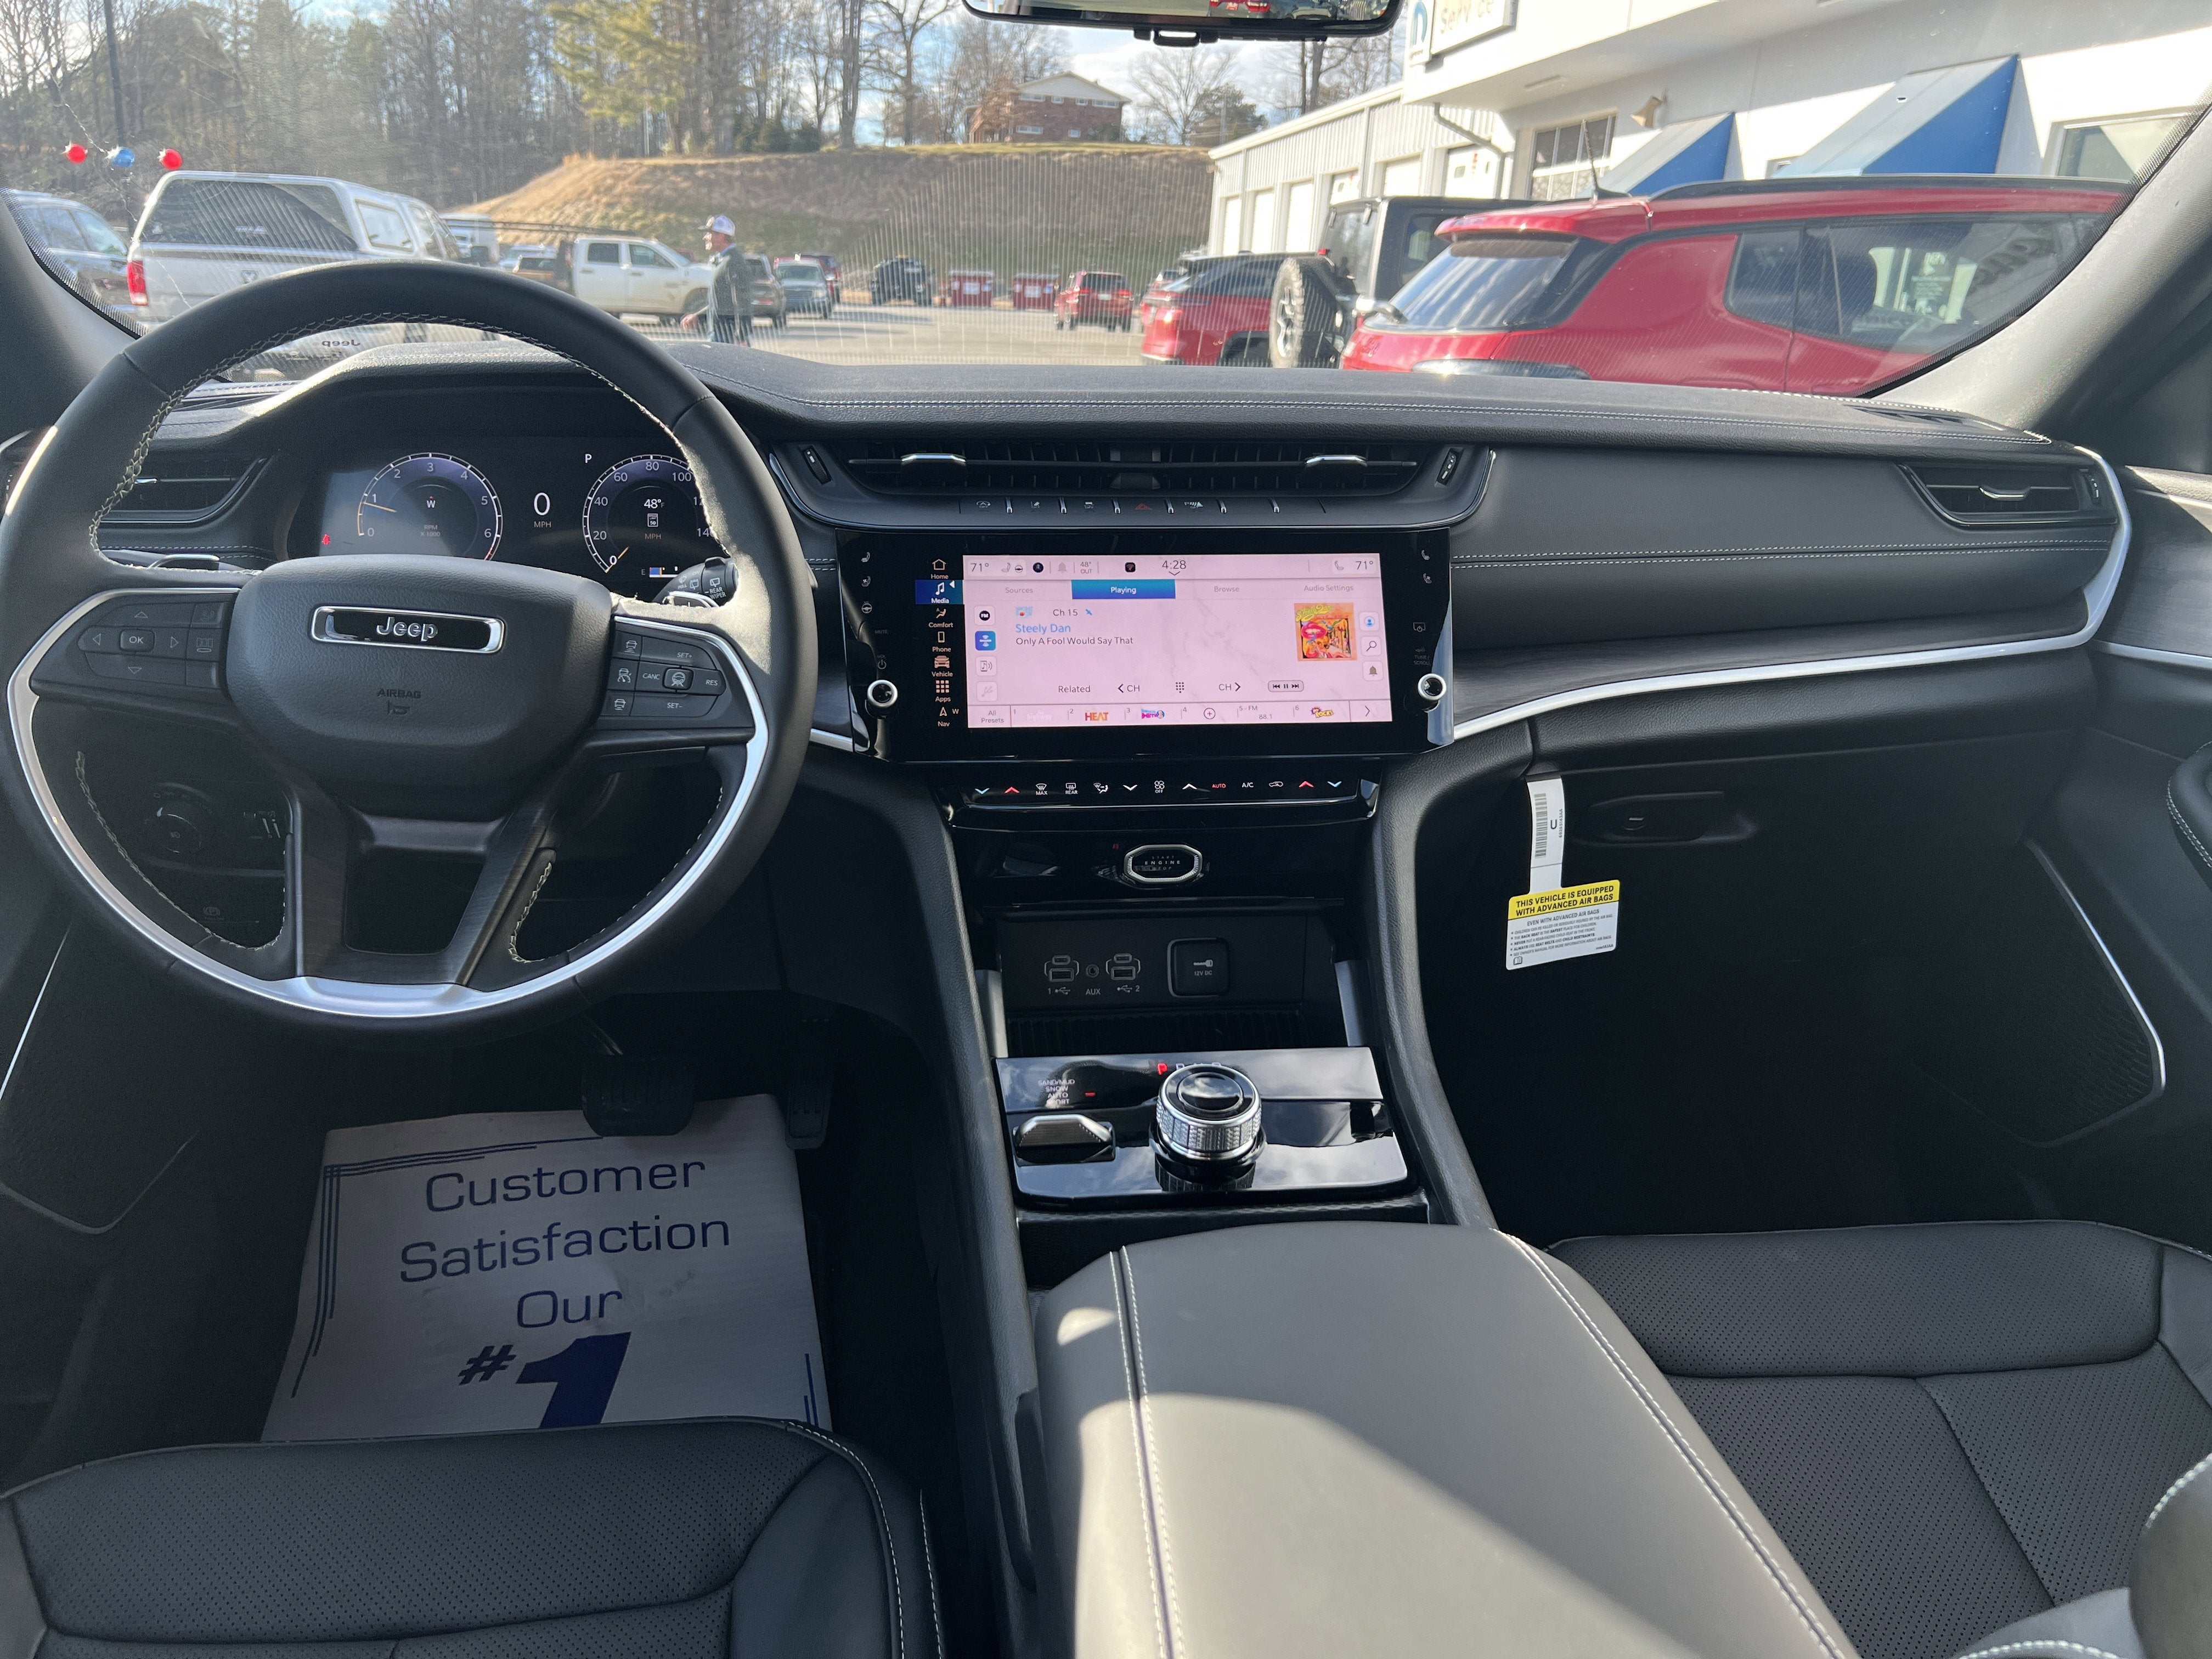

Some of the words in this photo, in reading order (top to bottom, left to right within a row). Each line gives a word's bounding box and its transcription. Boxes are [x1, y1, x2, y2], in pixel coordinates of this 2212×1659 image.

[585, 454, 592, 463] P
[427, 463, 433, 472] 3
[646, 462, 659, 471] 80
[394, 470, 401, 478] 2
[461, 471, 467, 479] 4
[614, 472, 628, 482] 60
[672, 472, 691, 482] 100
[373, 494, 376, 502] 1
[481, 496, 488, 505] 5
[594, 497, 608, 506] 40
[534, 492, 550, 516] 0
[368, 528, 374, 537] 0
[484, 529, 492, 538] 6
[593, 531, 607, 540] 20
[610, 555, 617, 565] 0
[1162, 560, 1187, 569] 4:28
[1110, 586, 1136, 595] Playing
[1325, 584, 1353, 592] Settings
[376, 617, 438, 642] Jeep
[1016, 624, 1047, 634] Steely
[1051, 624, 1071, 633] Dan
[129, 636, 144, 644] OK
[1016, 637, 1036, 646] Only
[1097, 637, 1113, 646] Say
[377, 689, 421, 698] AIRBAG
[1085, 712, 1108, 721] HEAT
[1550, 819, 1557, 829] U
[1516, 899, 1533, 907] THIS
[1536, 893, 1566, 904] VEHICLE
[1577, 885, 1614, 897] EQUIPPED
[1516, 907, 1535, 916] WITH
[1537, 900, 1577, 912] ADVANCED
[1594, 894, 1613, 902] BAGS
[1158, 1063, 1167, 1075] P
[425, 1160, 706, 1212] Customer
[400, 1215, 731, 1283] Satisfaction
[516, 1289, 623, 1328] Our
